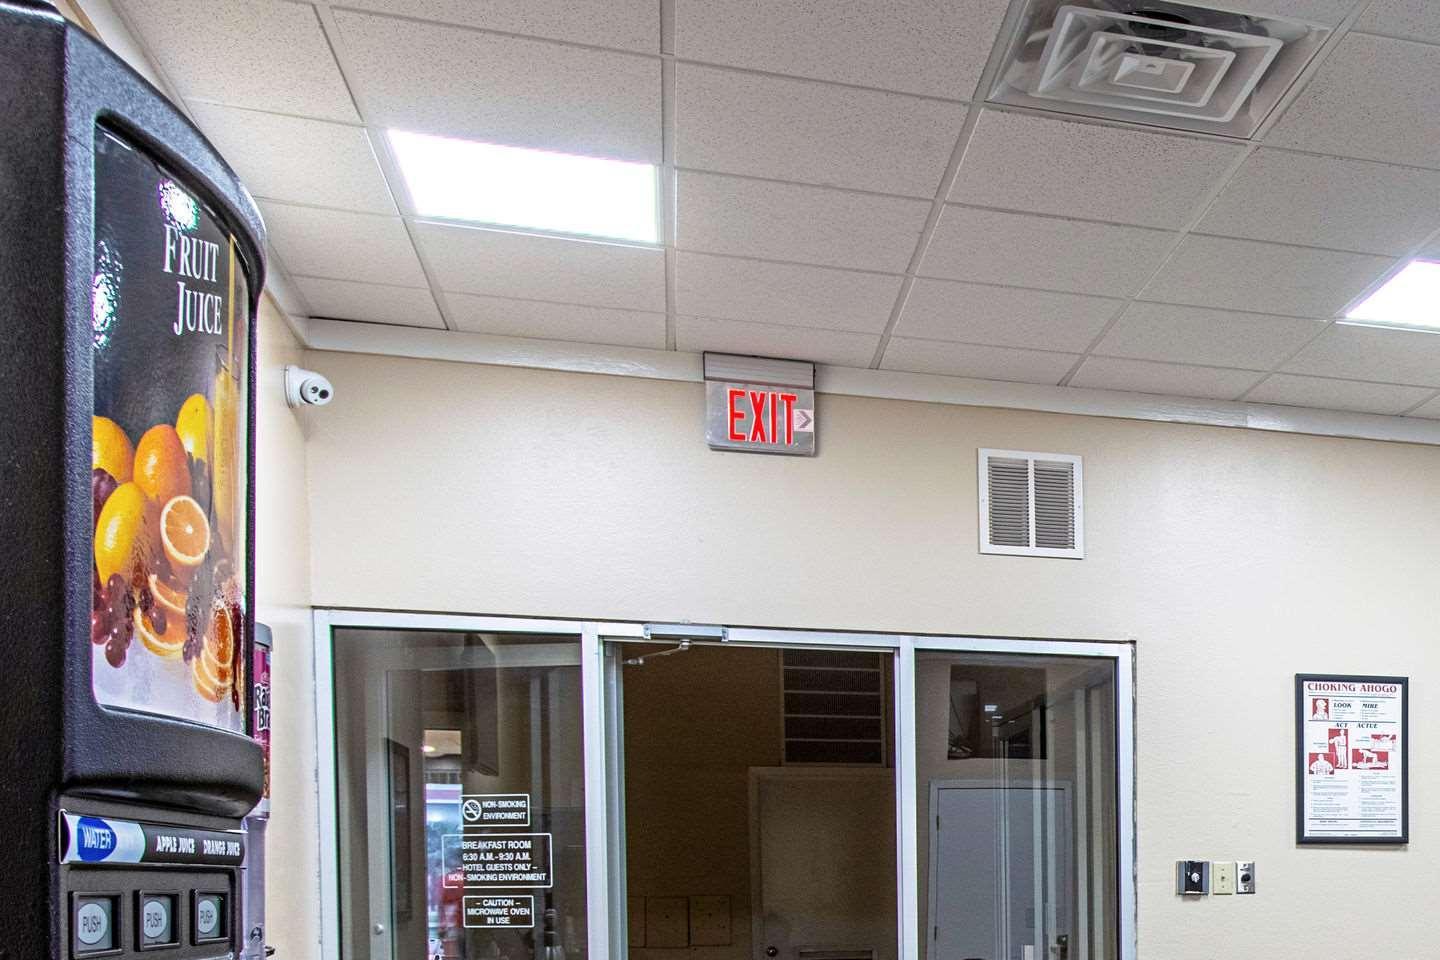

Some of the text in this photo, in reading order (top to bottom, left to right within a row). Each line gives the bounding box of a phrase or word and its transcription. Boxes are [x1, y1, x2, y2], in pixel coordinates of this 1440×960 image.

[163, 223, 219, 282] FRUIT
[173, 281, 222, 335] JUICE
[728, 388, 798, 446] EXIT
[1307, 683, 1397, 693] CHOKING AHOGO
[483, 812, 526, 820] ENVIRONMENT
[83, 826, 112, 849] WATER
[156, 836, 195, 853] APPLE JUICE
[203, 840, 240, 856] ORANGE JUICE
[462, 841, 531, 850] BREAKFAST ROOM
[463, 853, 478, 861] 6:30
[499, 873, 546, 881] ENVIRONMENT
[200, 910, 213, 924] PUSH
[467, 908, 508, 916] MICROWAVE
[83, 916, 101, 933] PUSH
[146, 913, 162, 928] PUSH
